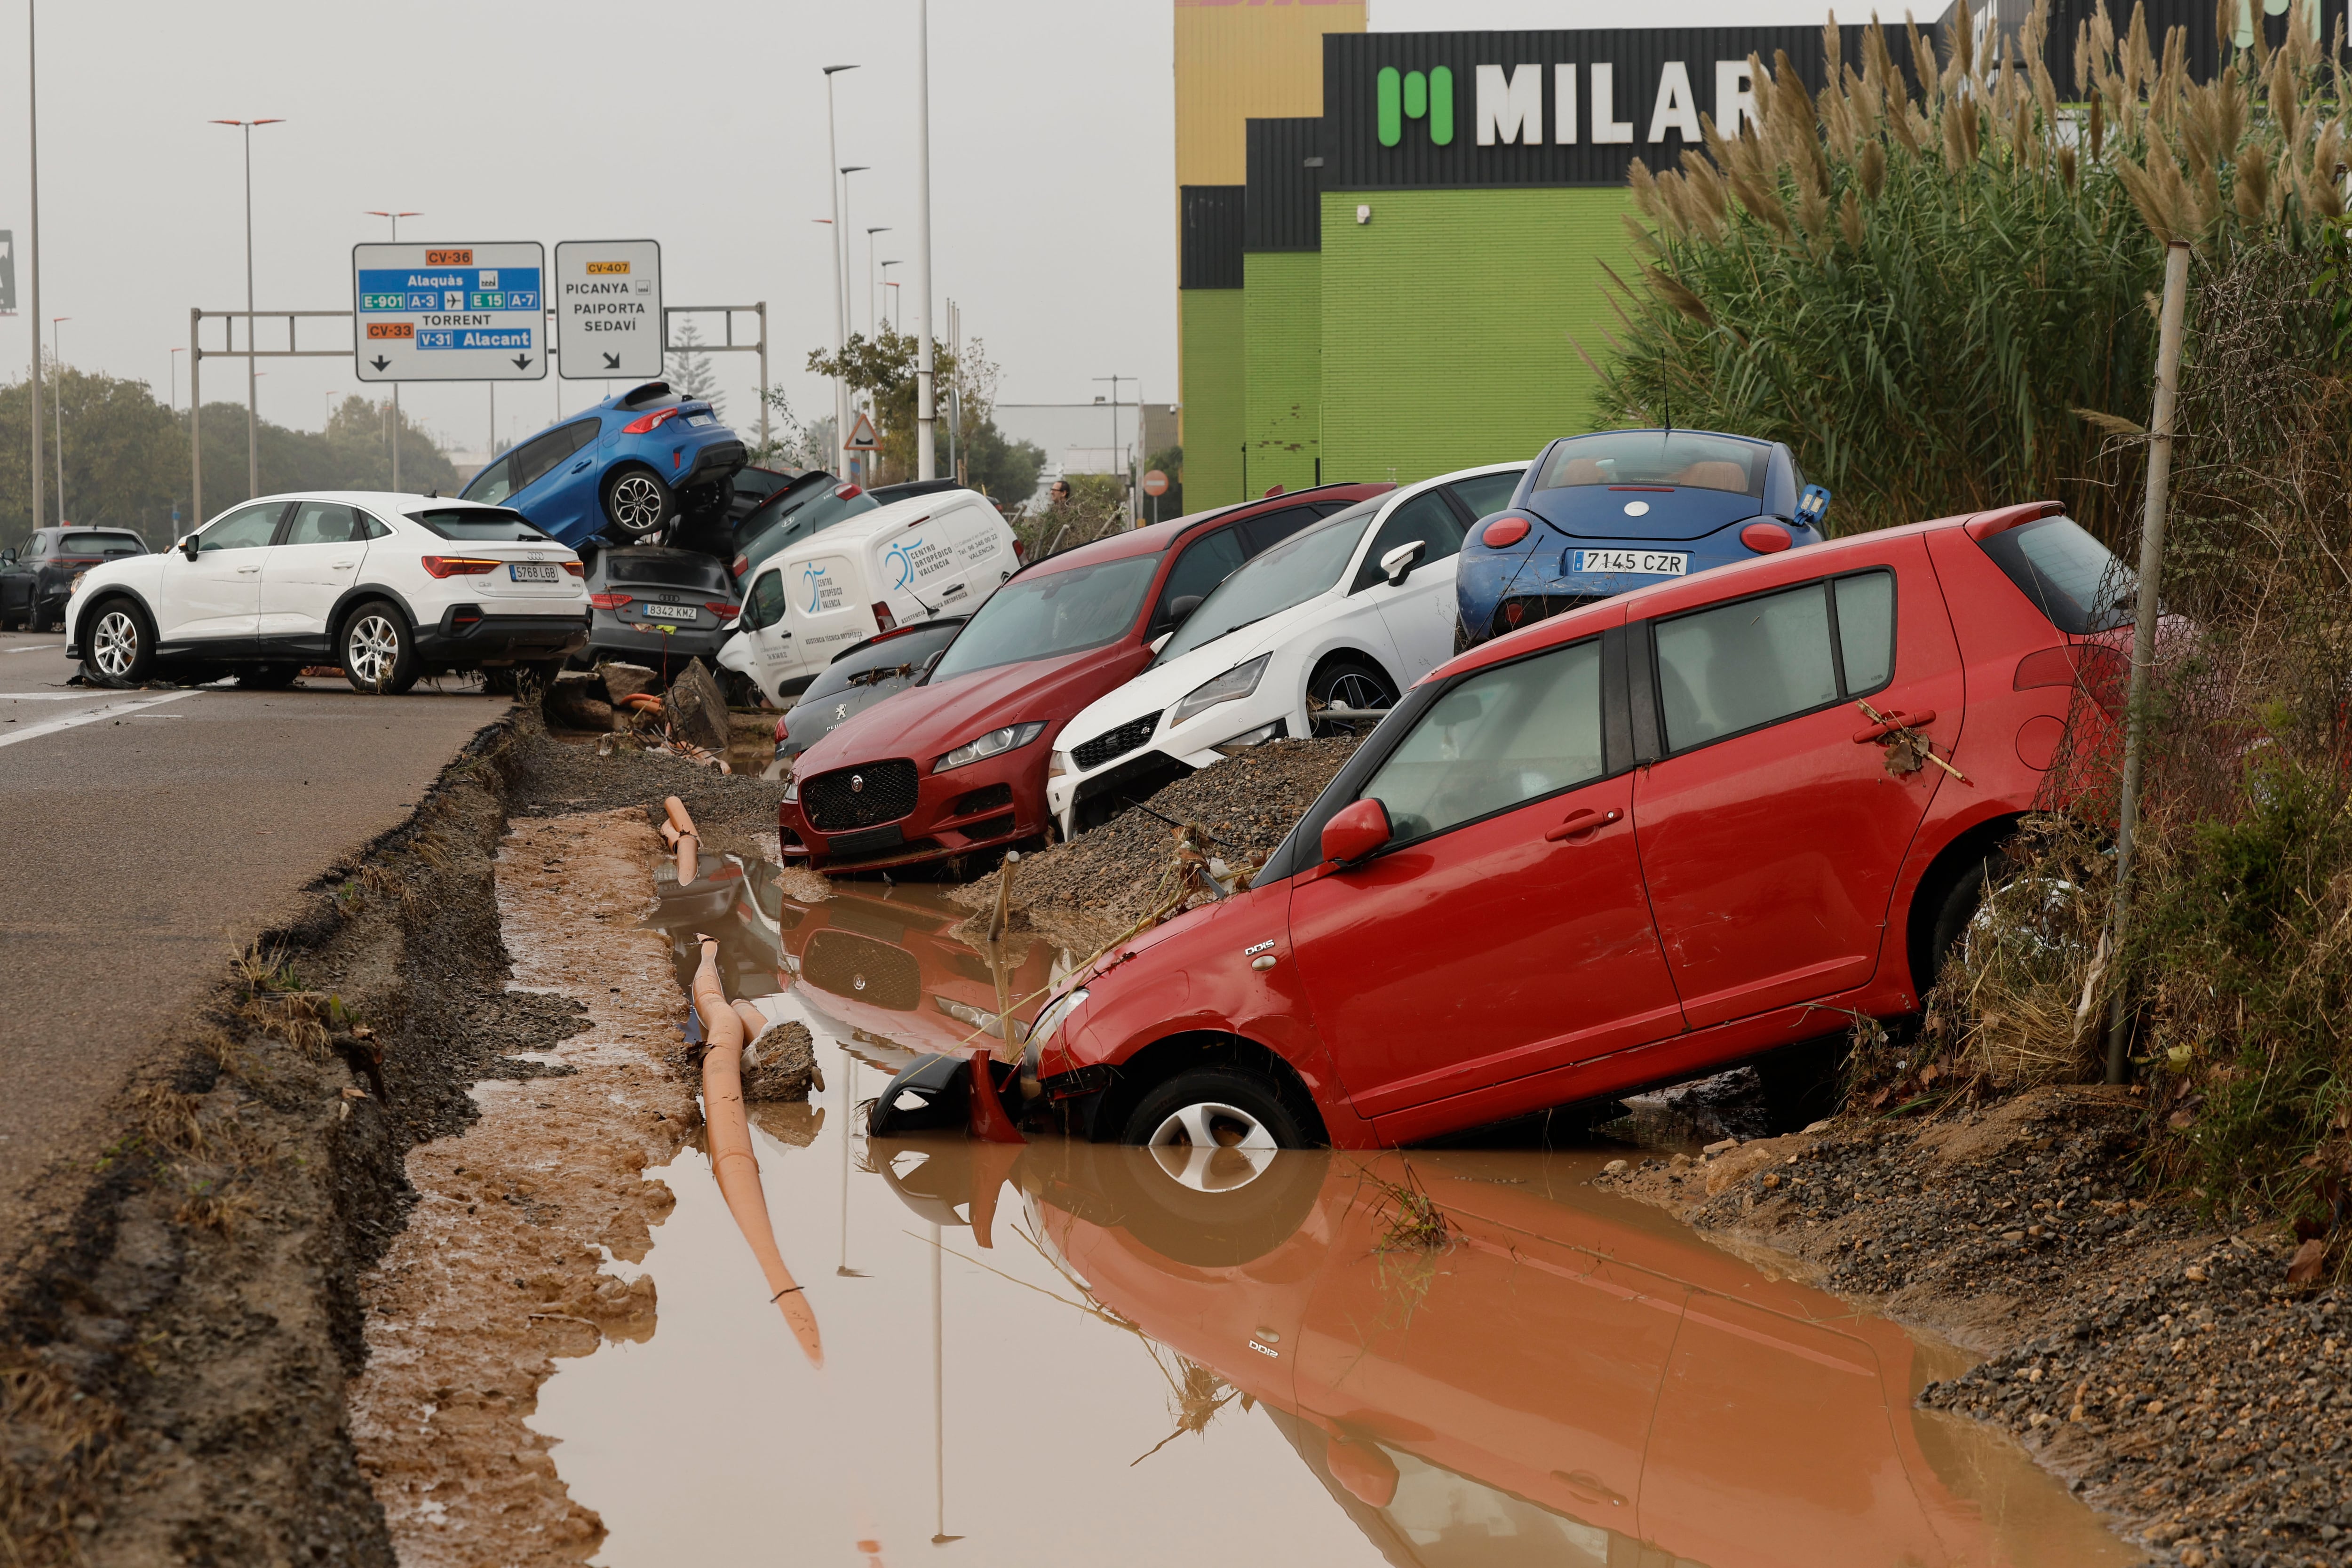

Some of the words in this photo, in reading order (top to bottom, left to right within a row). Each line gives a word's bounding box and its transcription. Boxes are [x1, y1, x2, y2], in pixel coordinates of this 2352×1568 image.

[1476, 60, 1772, 145] MILAR
[429, 252, 470, 263] CV-36
[588, 263, 628, 272] CV-407
[407, 274, 463, 288] Alaquàs
[566, 283, 629, 294] PICANYA
[364, 295, 403, 308] E-901
[411, 295, 435, 307] A-3
[473, 294, 482, 306] E
[487, 294, 502, 306] 15
[511, 294, 534, 306] A-7
[574, 303, 645, 314] PAIPORTA
[422, 314, 492, 326] TORRENT
[585, 317, 636, 331] SEDAVÍ
[370, 325, 411, 336] CV-33
[421, 333, 450, 345] V-31
[463, 331, 529, 346] Alacant
[975, 540, 985, 548] 346
[910, 544, 936, 559] CENTRO
[914, 547, 953, 568] ORTOPÉDICO
[968, 544, 995, 560] VALENCIA
[918, 558, 950, 576] VALENCIA
[1587, 553, 1636, 569] 7145
[1644, 555, 1682, 573] CZR
[516, 567, 538, 578] 5768
[540, 567, 556, 579] LGB
[817, 577, 832, 587] CENTRO
[820, 586, 842, 598] ORTOPÉDICO
[822, 599, 842, 609] VALENCIA
[901, 609, 926, 624] ASISTENCIA
[944, 591, 968, 605] ORTOPÉDICA
[650, 605, 673, 616] 8342
[676, 607, 694, 618] KMZ
[840, 630, 863, 640] ORTOPÉDICA
